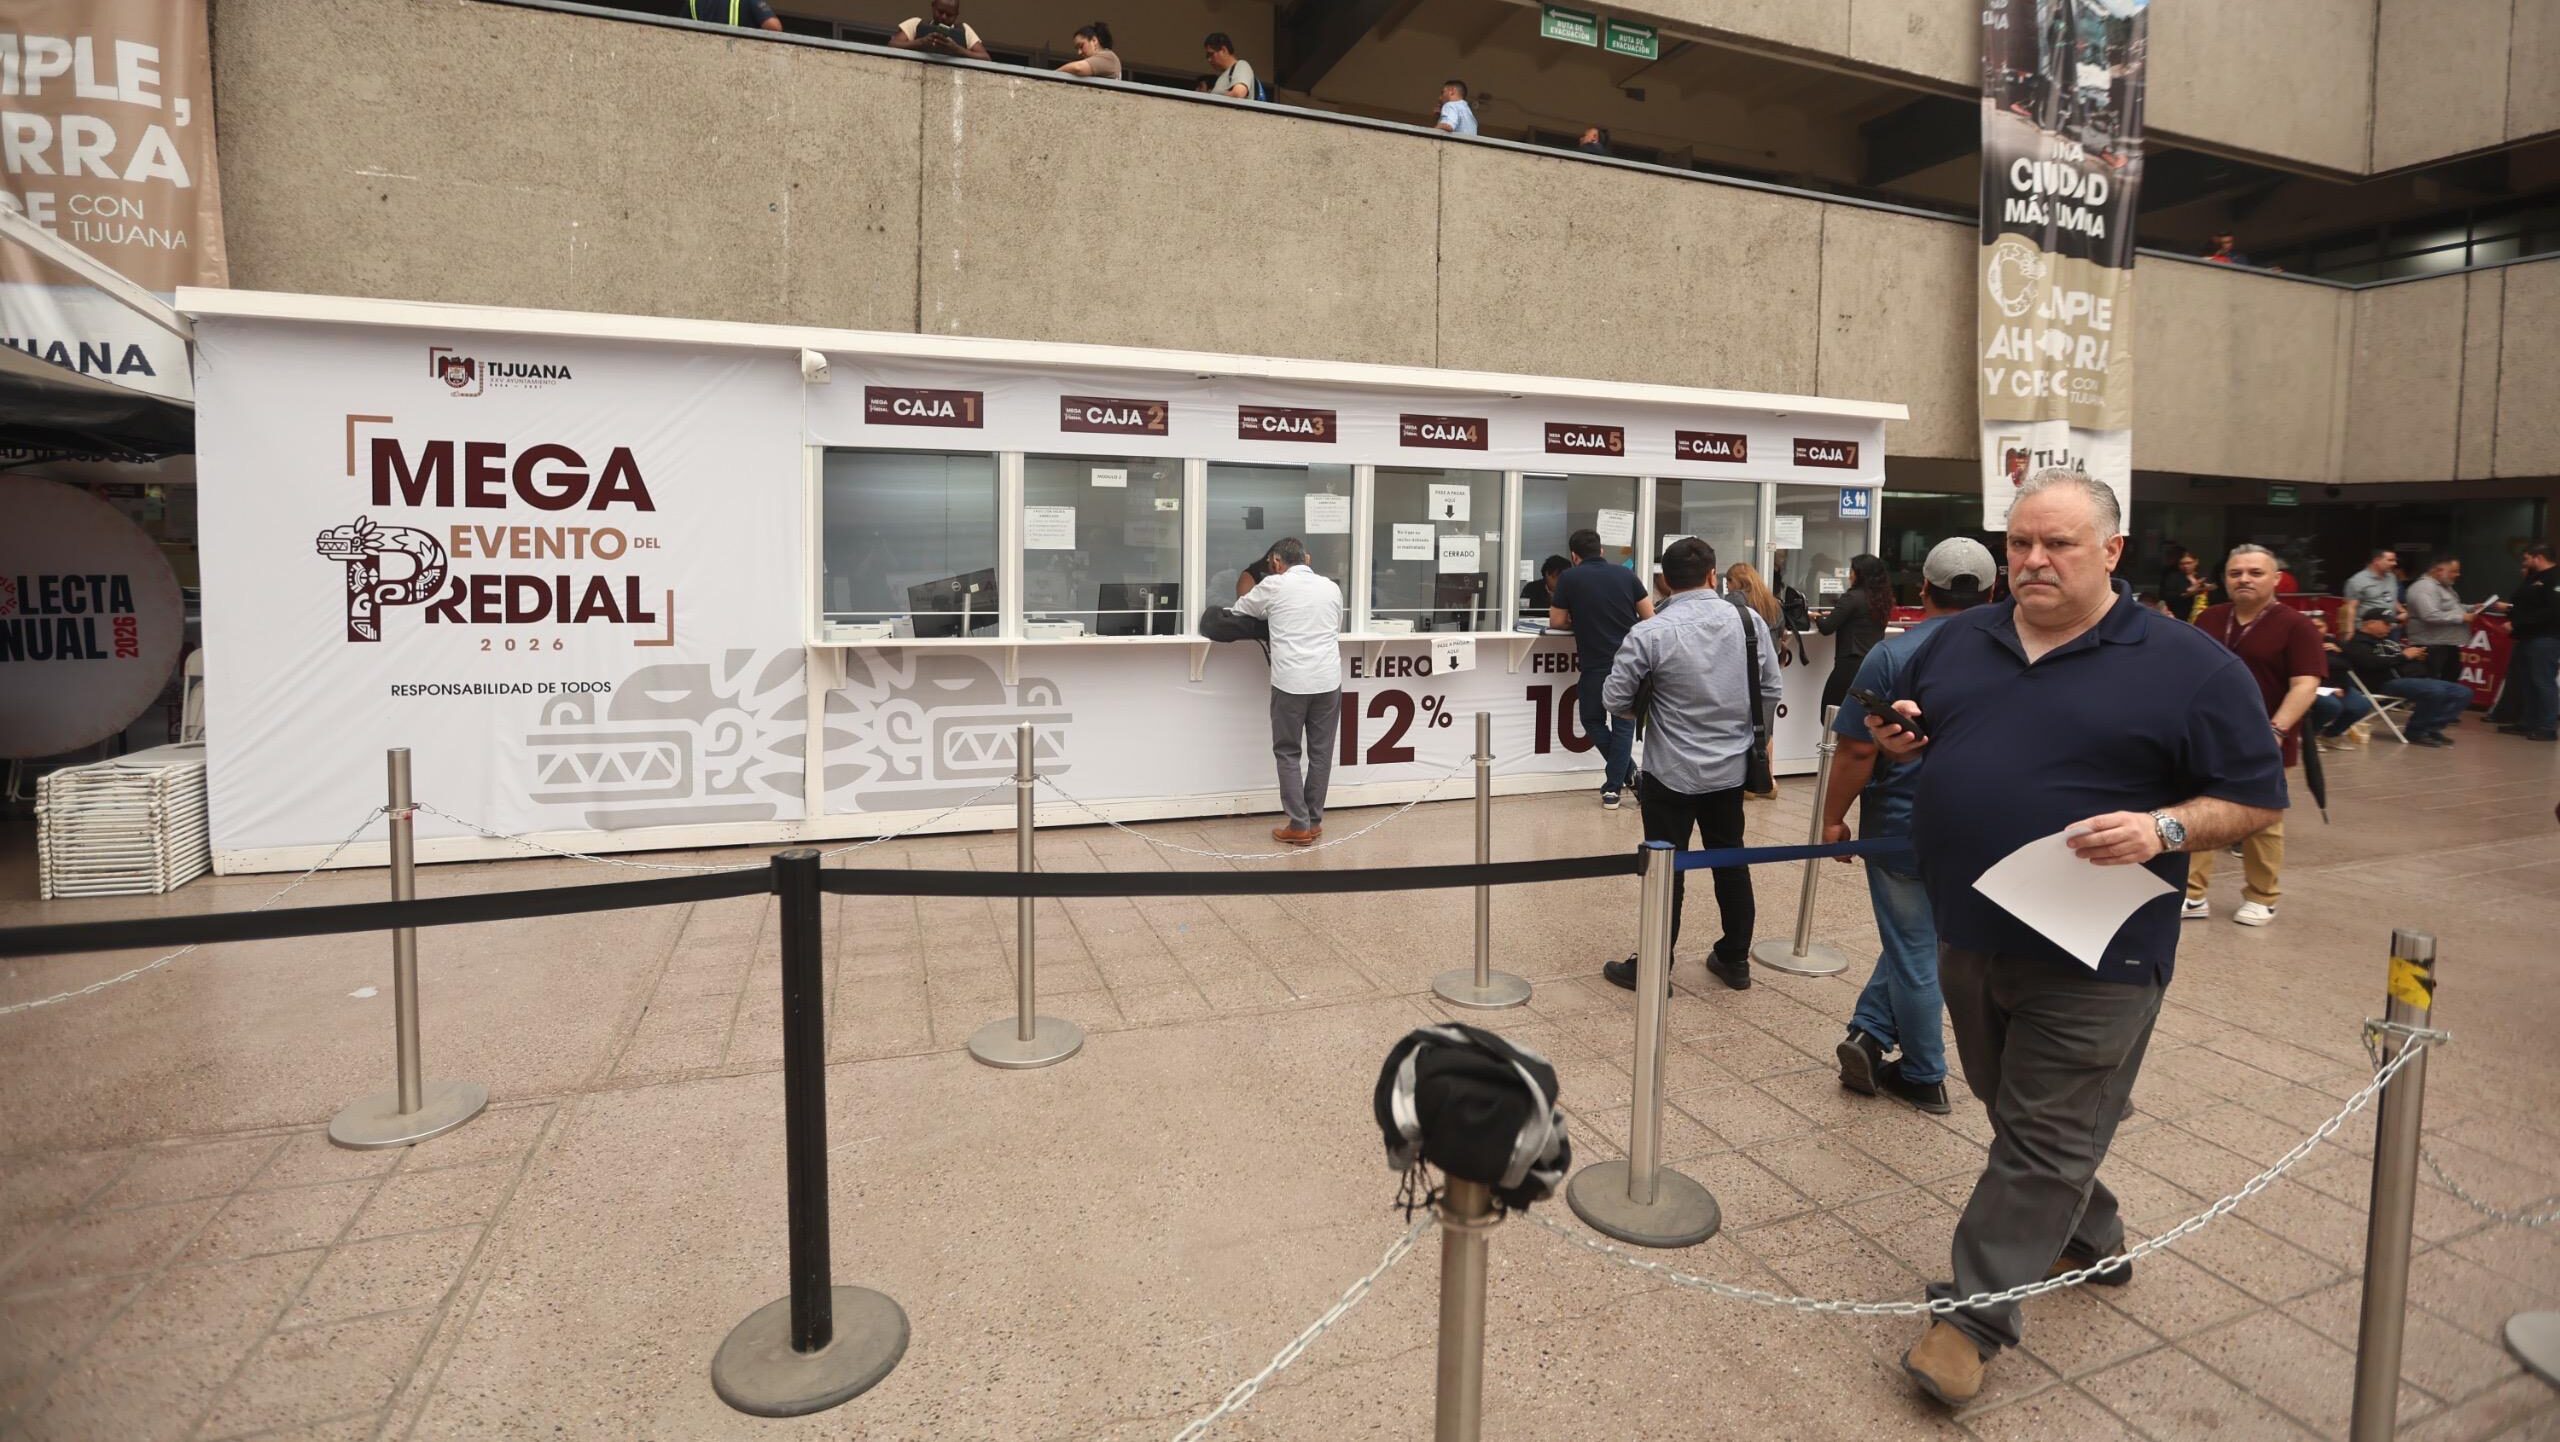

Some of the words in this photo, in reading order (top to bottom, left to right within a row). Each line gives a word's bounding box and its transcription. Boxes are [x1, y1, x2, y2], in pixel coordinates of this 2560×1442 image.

[1557, 20, 1574, 31] RUTA
[1574, 22, 1584, 32] DE
[1619, 34, 1635, 44] RUTA
[1635, 36, 1644, 46] DE
[68, 194, 144, 220] CON
[70, 220, 188, 250] TIJUANA
[488, 362, 572, 380] TIJUANA
[1984, 367, 2006, 396] Y
[506, 378, 557, 386] AYUNTAMIENTO
[893, 398, 956, 418] CAJA
[963, 397, 976, 422] 1
[1086, 407, 1143, 426] CAJA
[1147, 405, 1165, 430] 2
[1262, 416, 1314, 434] CAJA
[1312, 417, 1325, 436] 3
[1421, 424, 1468, 442] CAJA
[1466, 425, 1478, 443] 4
[1564, 432, 1606, 448] CAJA
[1608, 431, 1622, 452] 5
[1692, 439, 1731, 455] CAJA
[1732, 439, 1745, 459] 6
[1809, 446, 1844, 461] CAJA
[1846, 446, 1857, 465] 7
[371, 438, 656, 512] MEGA
[450, 524, 628, 561] EVENTO
[633, 537, 661, 549] DEL
[316, 515, 656, 643] PREDIAL
[17, 574, 135, 615] LECTA
[113, 616, 140, 659] 2026
[480, 638, 564, 652] 2026
[391, 682, 533, 697] RESPONSABILIDAD
[538, 682, 556, 694] DE
[560, 681, 612, 694] TODOS
